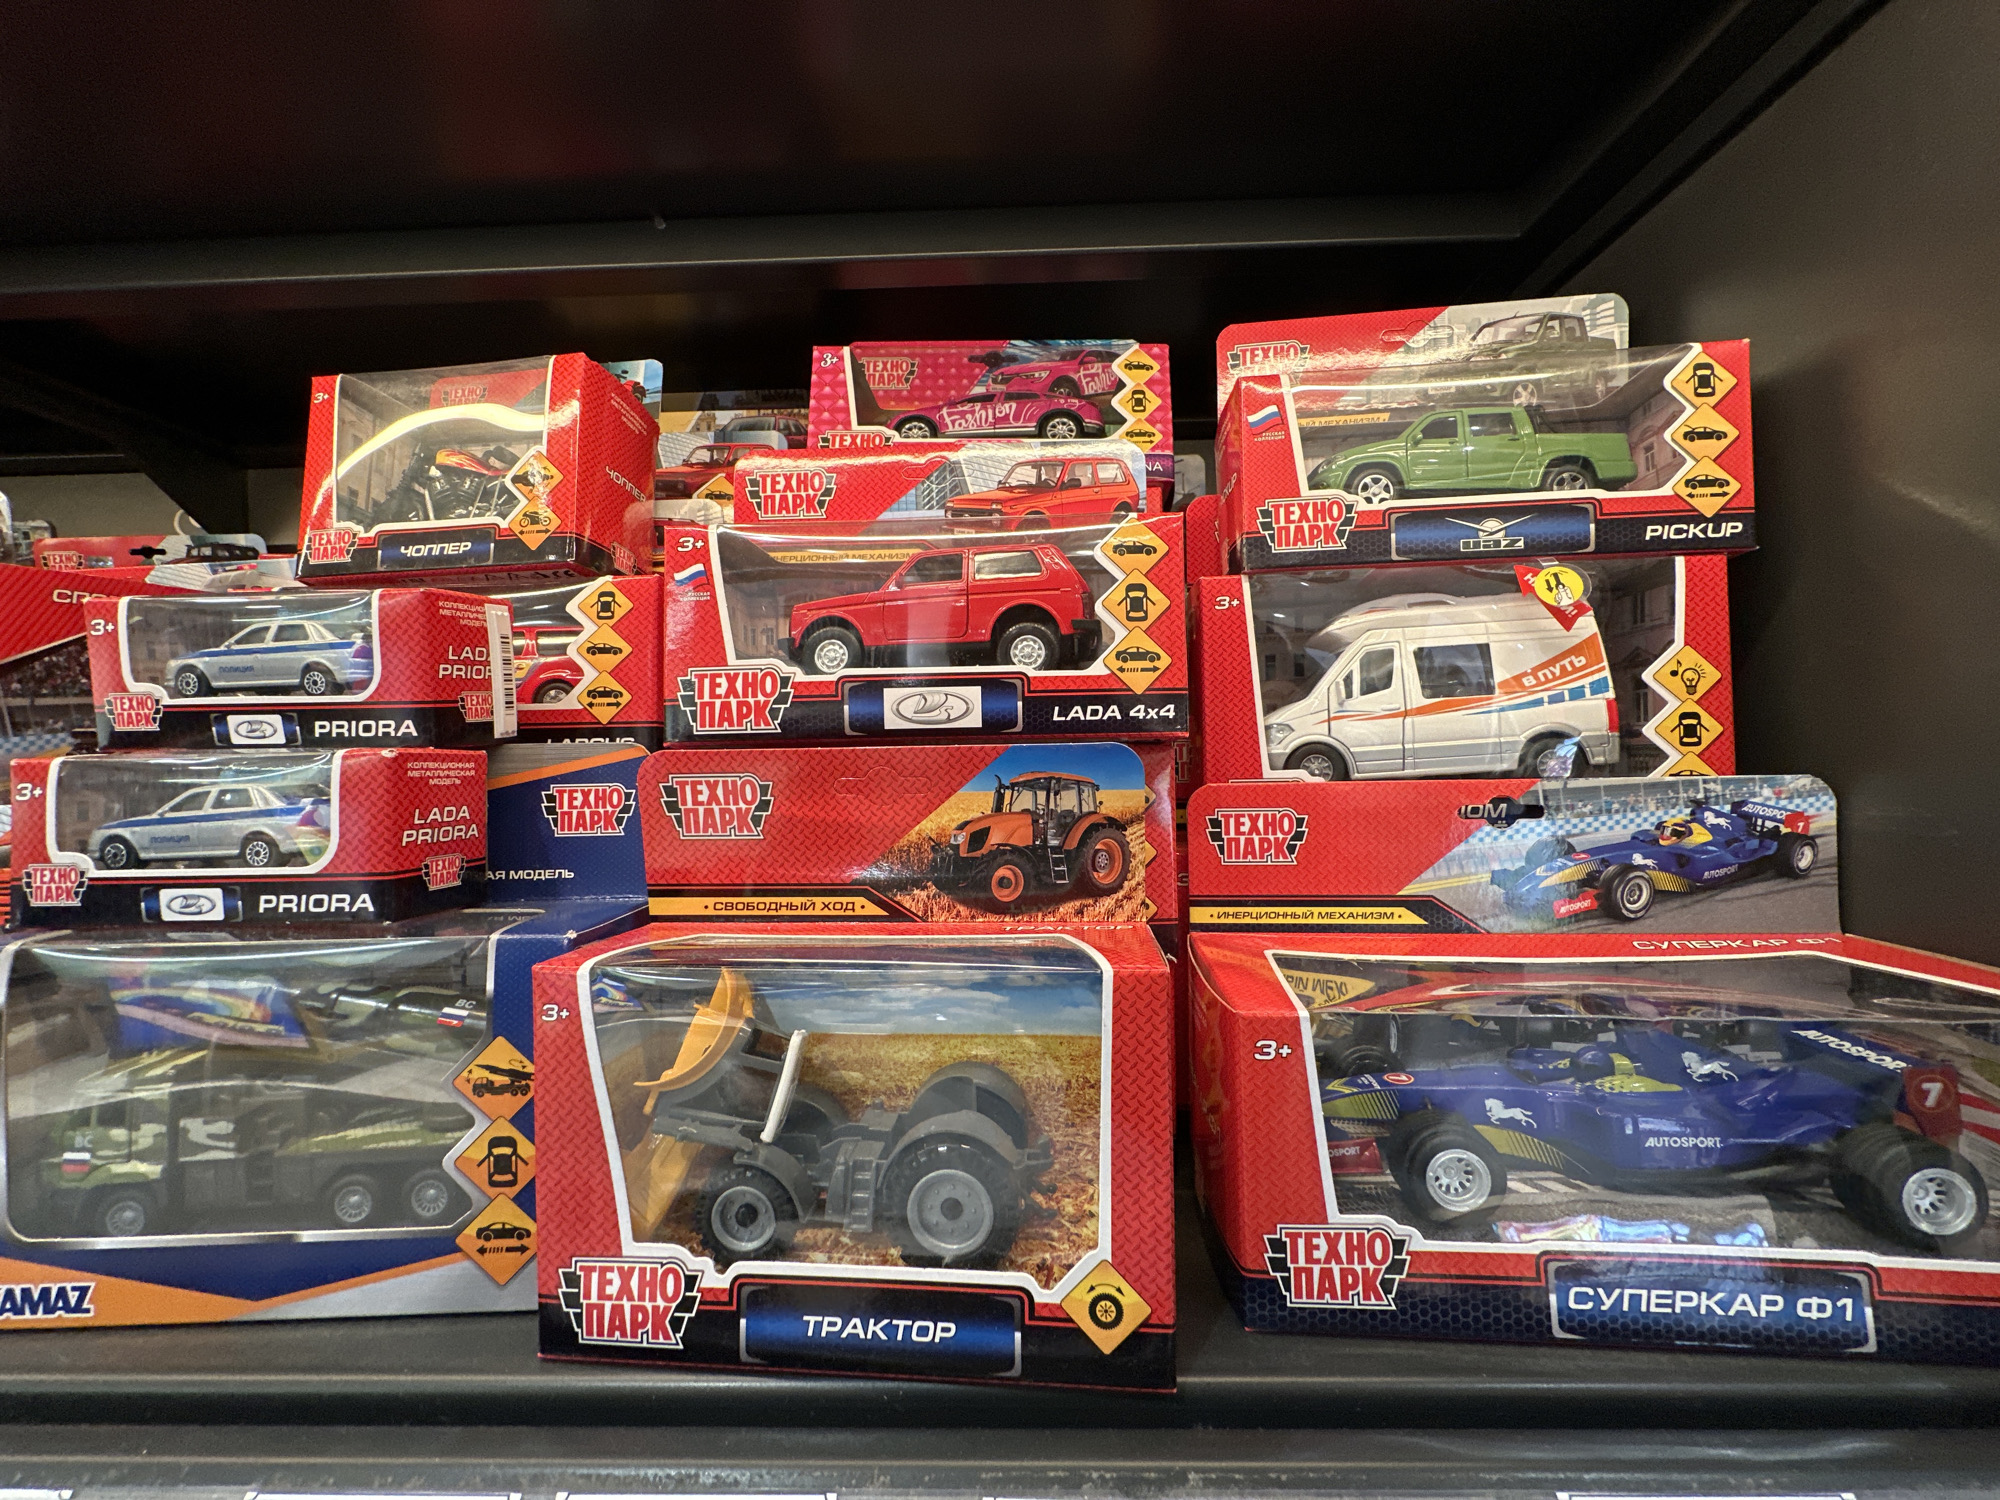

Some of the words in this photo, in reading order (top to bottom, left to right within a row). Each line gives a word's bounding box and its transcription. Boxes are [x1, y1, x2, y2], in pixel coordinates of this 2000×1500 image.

[820, 353, 840, 367] 3+
[1238, 343, 1301, 367] ТЕХНО
[864, 359, 911, 374] ТЕХНО
[866, 373, 907, 388] ПАРК
[313, 392, 329, 404] 3+
[829, 433, 885, 448] ТЕХНО
[605, 465, 647, 502] ЧОППЕР
[759, 471, 826, 494] ТЕХНО
[762, 493, 823, 517] ПАРК
[1271, 499, 1345, 526] ТЕХНО
[311, 531, 353, 549] ТЕХНО
[1275, 522, 1340, 548] ПАРК
[1645, 521, 1743, 541] PICKUP
[311, 544, 350, 562] ПАРК
[399, 541, 473, 558] ЧОППЕР
[677, 537, 705, 552] 3+
[1214, 595, 1240, 611] 3+
[90, 619, 115, 636] 3+
[448, 645, 492, 661] LAD
[1539, 653, 1588, 683] ПУТЬ
[695, 671, 779, 701] ТЕХНО
[112, 695, 156, 712] ТЕХНО
[464, 693, 493, 707] ТЕХНО
[116, 712, 155, 729] ПАРК
[466, 706, 492, 720] ПАРК
[700, 699, 773, 729] ПАРК
[1052, 702, 1122, 722] LADA
[1129, 702, 1176, 720] 4x4
[314, 719, 418, 738] PRIORA
[407, 761, 475, 770] КОЛЛЕКЦИОННАЯ
[407, 769, 476, 778] МЕТАЛЛИЧЕСКАЯ
[428, 777, 462, 786] МОДЕЛЬ
[15, 782, 43, 802] 3+
[554, 785, 624, 811] ТЕХНО
[673, 779, 759, 807] ТЕХНО
[413, 805, 471, 825] LADA
[556, 809, 620, 833] ПАРК
[681, 805, 756, 835] ПАРК
[1741, 803, 1793, 820] AUTOSPO
[1219, 812, 1295, 837] ТЕХНО
[401, 823, 479, 847] PRIORA
[1223, 836, 1291, 861] ПАРК
[427, 854, 461, 874] ТЕХНО
[1702, 864, 1739, 880] AUTOSPORT
[31, 865, 79, 884] ТЕХНО
[429, 870, 460, 888] ПАРК
[509, 869, 575, 881] МОДЕЛЬ
[34, 884, 76, 904] ПАРК
[258, 893, 375, 914] PRIORA
[713, 899, 818, 914] СВОБОДНЫЙ
[820, 899, 857, 914] ХОД
[1216, 909, 1314, 922] ИНЕРЦИОННЫЙ
[1316, 909, 1396, 921] МЕХАНИЗМ
[1559, 898, 1592, 914] AUTOSPORT
[1632, 937, 1789, 950] СУПЕРКАР
[1796, 937, 1842, 945] Ф1
[541, 1004, 571, 1023] 3+
[1253, 1039, 1293, 1061] 3+
[1791, 1029, 1913, 1073] AUTOSPOR
[1921, 1082, 1944, 1108] 7
[1283, 1231, 1392, 1268] ТЕХНО
[579, 1264, 682, 1303] ТЕХНО
[1291, 1265, 1384, 1304] ПАРК
[0, 1284, 93, 1317] AMAZ
[1568, 1286, 1785, 1318] СУПЕРКАР
[1796, 1296, 1855, 1323] Ф1
[584, 1301, 676, 1342] ПАРК
[803, 1315, 958, 1345] ТРАКТОР
